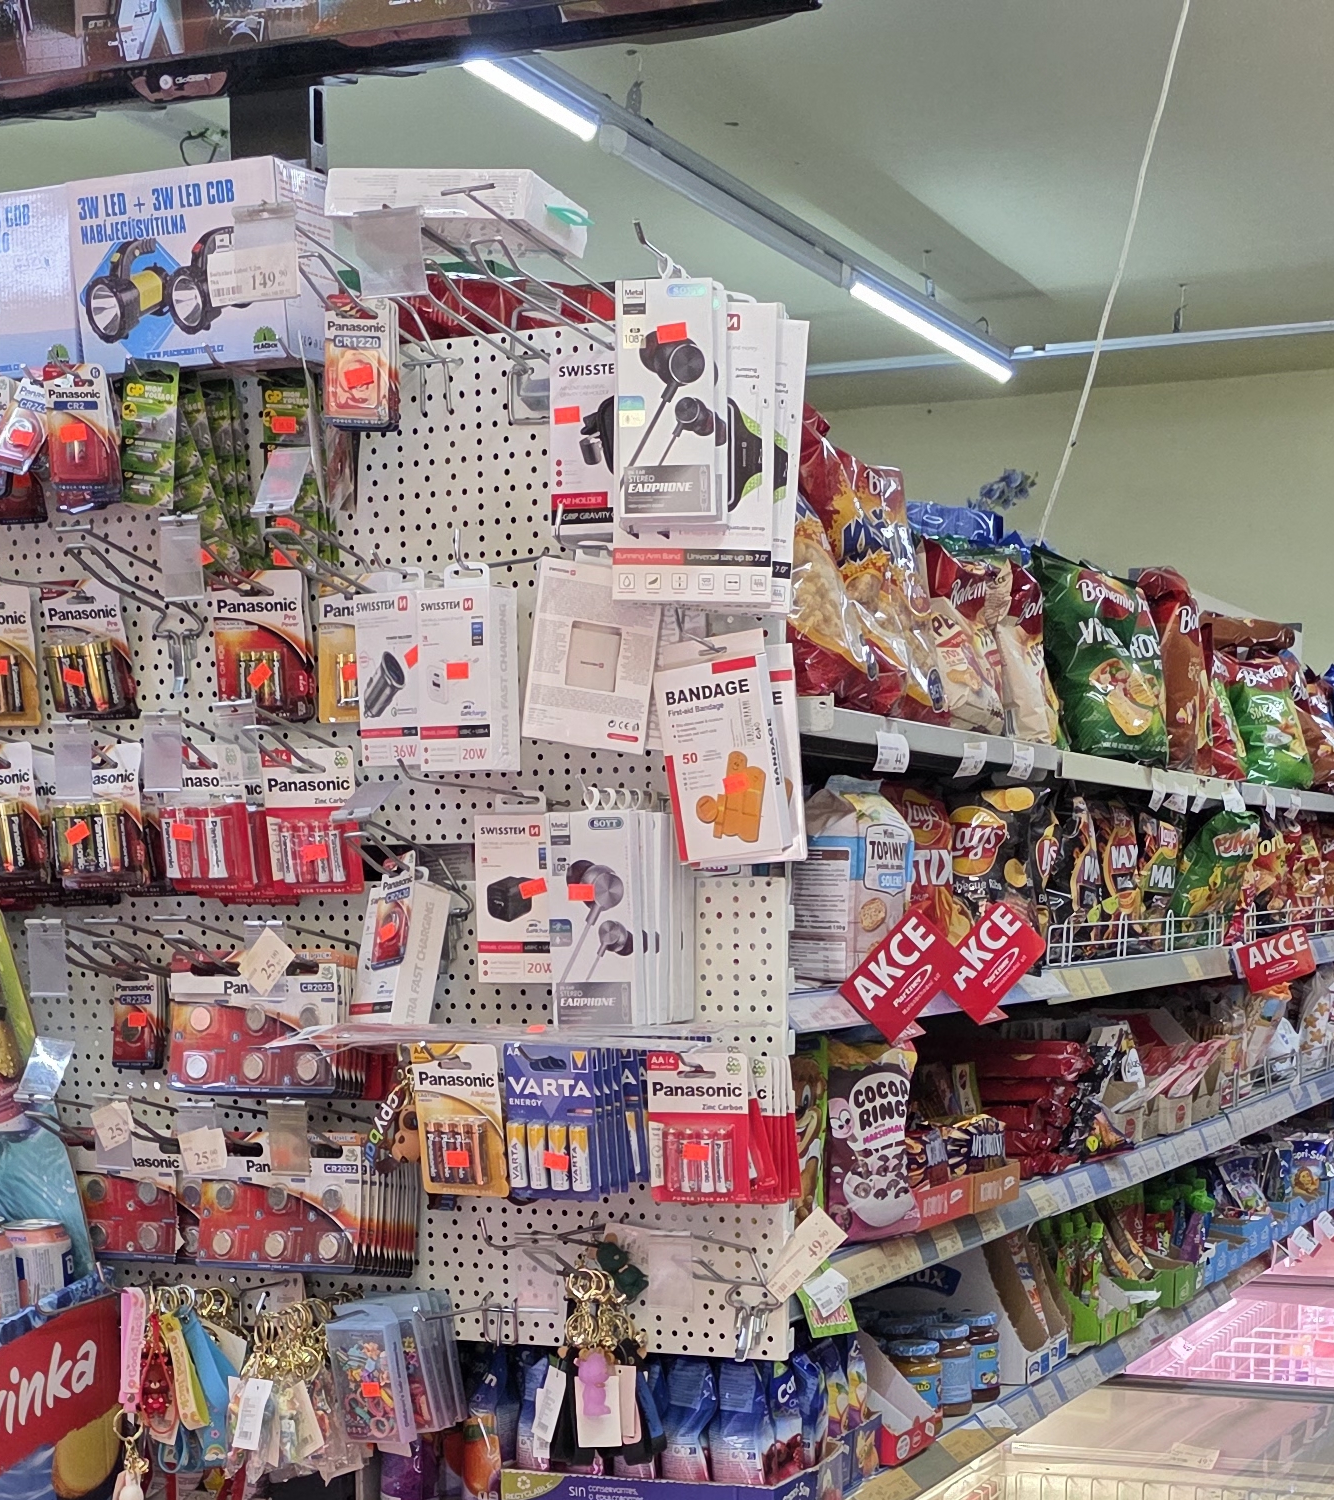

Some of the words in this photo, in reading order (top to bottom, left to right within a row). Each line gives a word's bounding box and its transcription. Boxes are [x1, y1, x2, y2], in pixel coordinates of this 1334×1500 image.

[77, 197, 101, 221] 3W
[104, 193, 127, 218] LED
[151, 186, 174, 211] 3W
[177, 182, 202, 207] LED
[206, 179, 235, 205] COB
[624, 288, 644, 297] Metal
[327, 320, 386, 333] Panasonic
[335, 336, 380, 348] CR1220
[48, 388, 101, 401] Panasonic
[66, 401, 86, 410] CR2
[627, 482, 693, 493] EARPHONE
[217, 597, 297, 613] Panasonic
[48, 606, 117, 622] Panasonic
[284, 613, 296, 621] Pro
[665, 679, 750, 706] BANDAGE
[668, 705, 693, 717] First-aid
[695, 702, 724, 712] Bandage
[393, 745, 417, 759] 36W
[462, 747, 487, 761] 20W
[682, 752, 698, 765] 50
[767, 718, 780, 785] BANDAGE
[267, 776, 350, 792] Panasonic
[593, 818, 618, 828] SOYT
[480, 827, 526, 835] SWISSTEN
[1111, 843, 1138, 869] MAX
[1249, 928, 1308, 969] AKCE
[853, 917, 935, 1011] AKCE
[982, 956, 1011, 987] Partner
[116, 983, 154, 993] Panasonic
[302, 983, 334, 992] CR2025
[892, 974, 922, 1007] Partner
[560, 998, 617, 1008] EARPHONE
[418, 1071, 495, 1089] Panasonic
[508, 1077, 592, 1097] VARTA
[651, 1081, 743, 1098] Panasonic
[853, 1078, 910, 1108] COCOA
[508, 1098, 543, 1107] ENERGY
[702, 1103, 719, 1111] Zinc
[720, 1103, 743, 1112] Carbon
[325, 1164, 356, 1174] CR2032
[571, 1145, 579, 1184] VARTA
[505, 1481, 553, 1500] RECYCLABLE
